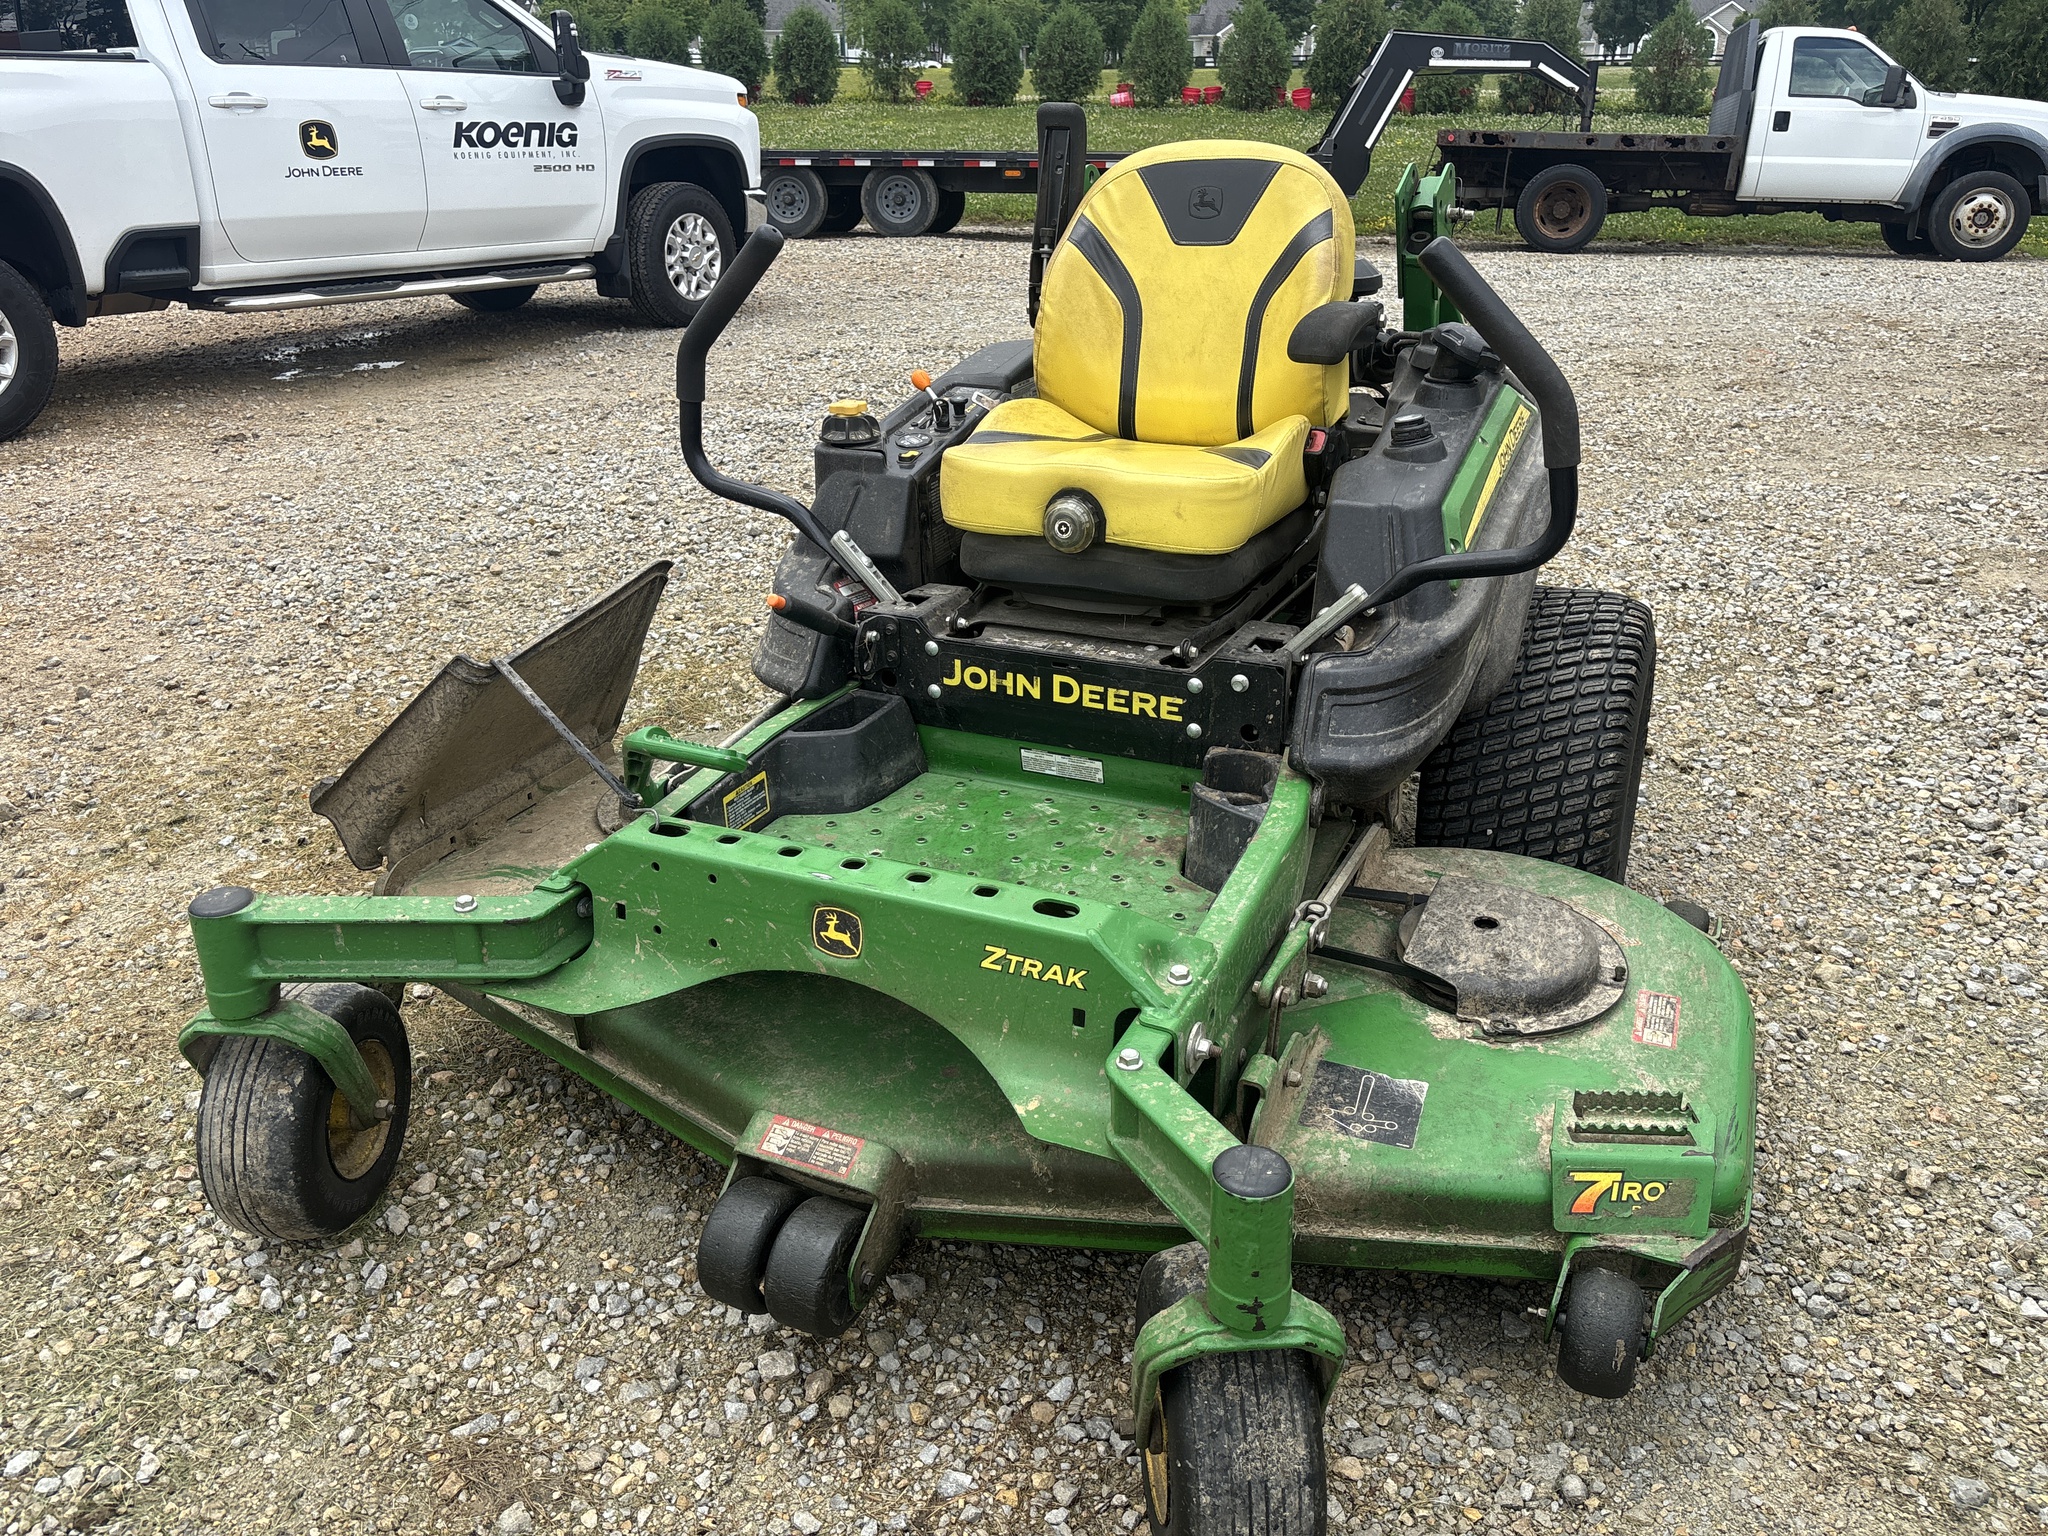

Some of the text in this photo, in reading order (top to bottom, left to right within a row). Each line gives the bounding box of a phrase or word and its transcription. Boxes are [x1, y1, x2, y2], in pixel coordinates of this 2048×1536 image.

[1454, 42, 1511, 56] MORITZ
[453, 150, 581, 160] KOENIG EQUIPMENT, INC.
[285, 165, 363, 178] JOHN DEERE
[533, 164, 595, 172] 2500 HD
[943, 659, 1183, 722] JOHN DEERE
[980, 944, 1089, 991] ZTRAK
[791, 1120, 816, 1133] DANGER
[831, 1132, 858, 1146] PELIGRO
